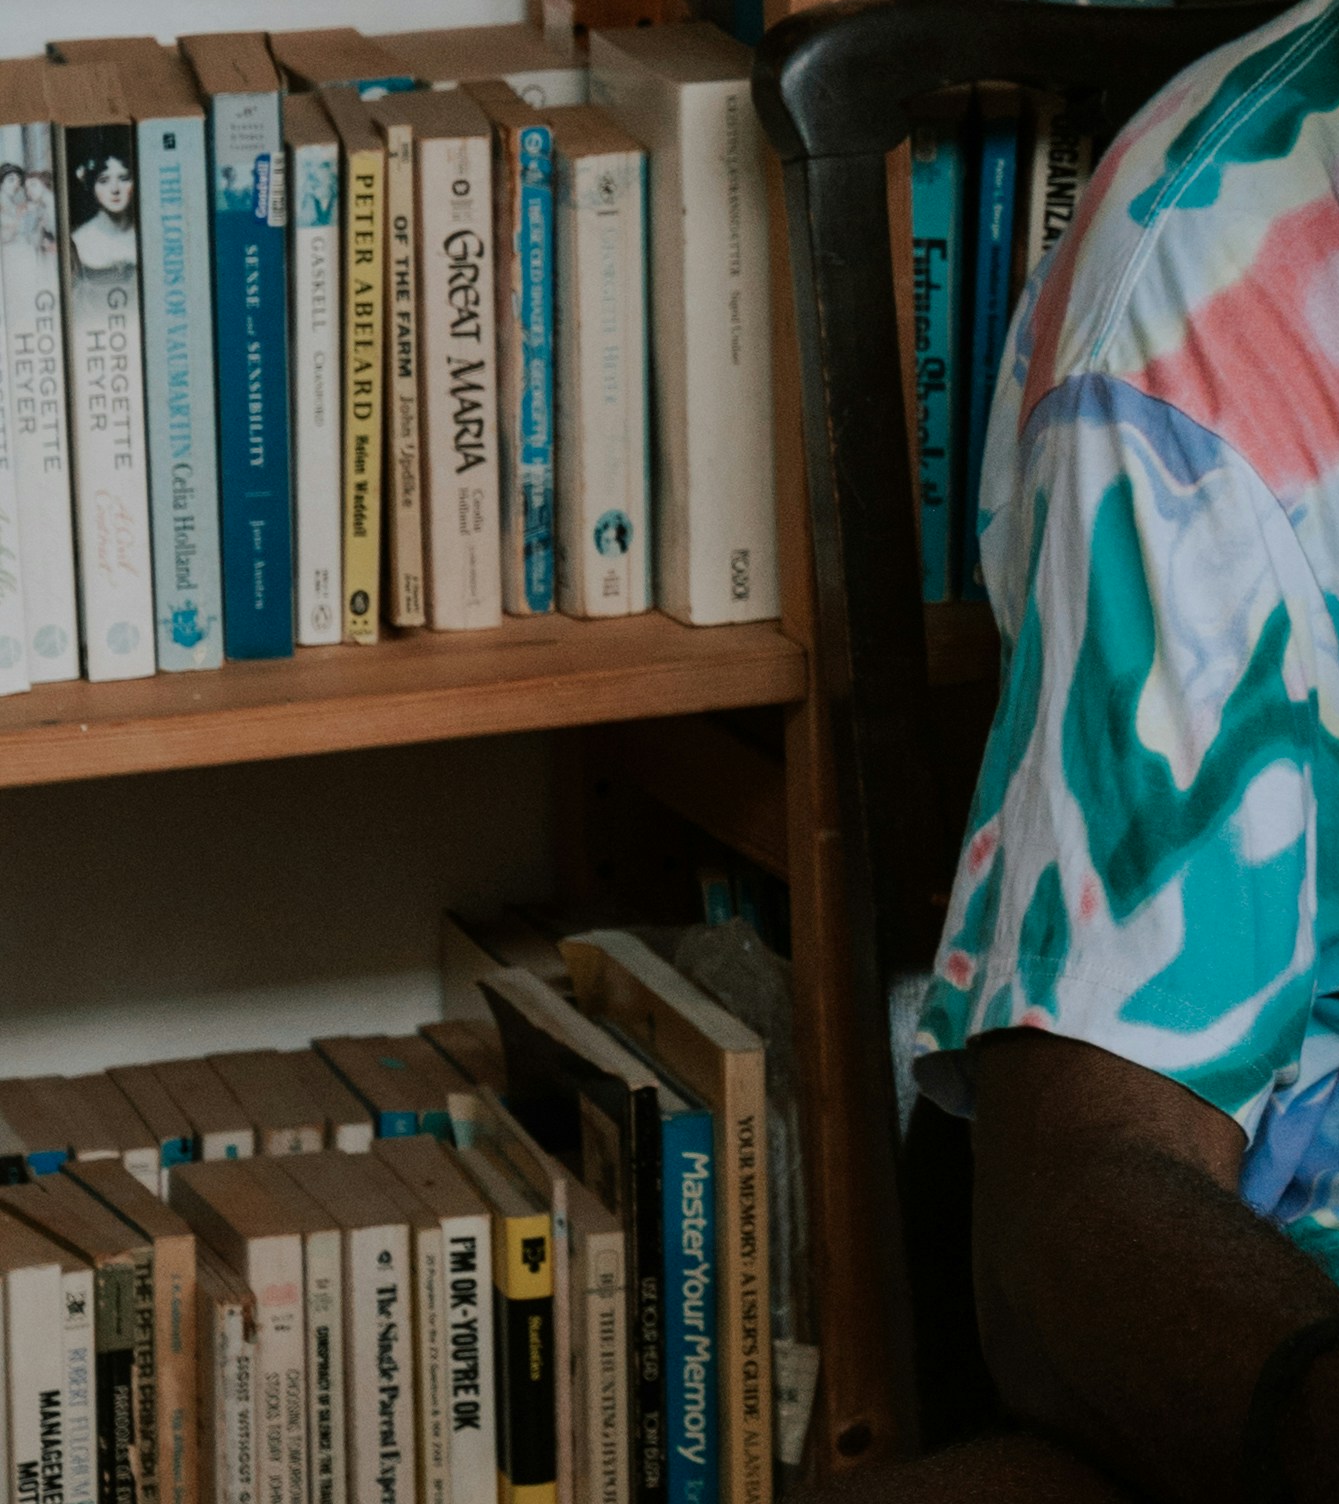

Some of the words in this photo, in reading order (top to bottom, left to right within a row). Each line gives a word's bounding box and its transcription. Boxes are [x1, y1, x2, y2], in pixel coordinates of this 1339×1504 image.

[158, 163, 182, 209] THE
[161, 214, 185, 284] LORDS
[354, 173, 377, 267] PETER
[393, 214, 410, 250] OF
[245, 244, 262, 309] SENSE
[309, 235, 328, 333] GASKELL
[395, 255, 411, 305] THE
[442, 228, 485, 344] GREAT
[352, 278, 375, 422] ABELARD
[396, 310, 413, 378] FARM
[14, 332, 36, 436] HEYER
[33, 289, 62, 473] GEORGETTE
[84, 330, 108, 433] HEYER
[105, 286, 134, 471] GEORGETTE
[166, 321, 194, 458] VAUMARTIN
[247, 341, 265, 468] SENSIBILITY
[445, 354, 487, 476] MARIA
[352, 433, 371, 475] Helen
[352, 479, 371, 538] Waddell
[172, 515, 198, 591] Holland
[729, 547, 751, 603] PICADOR
[737, 1115, 757, 1172] YOUR
[682, 1151, 710, 1260] Master
[133, 1258, 154, 1305] THE
[450, 1235, 478, 1274] I'M
[376, 1284, 399, 1320] The
[682, 1261, 710, 1331] Your
[741, 1290, 759, 1357] USER'S
[375, 1322, 400, 1382] Single
[598, 1310, 619, 1350] THE
[68, 1345, 89, 1408] ROBERT
[236, 1354, 252, 1403] SIGHT
[285, 1367, 303, 1432] CHOOSING
[599, 1350, 619, 1440] HUNTING
[677, 1334, 711, 1464] Memory
[742, 1360, 760, 1422] GUIDE
[237, 1410, 252, 1485] WITHOUT
[378, 1384, 400, 1450] Parent
[452, 1401, 482, 1432] OK
[68, 1415, 92, 1497] FULGHUM
